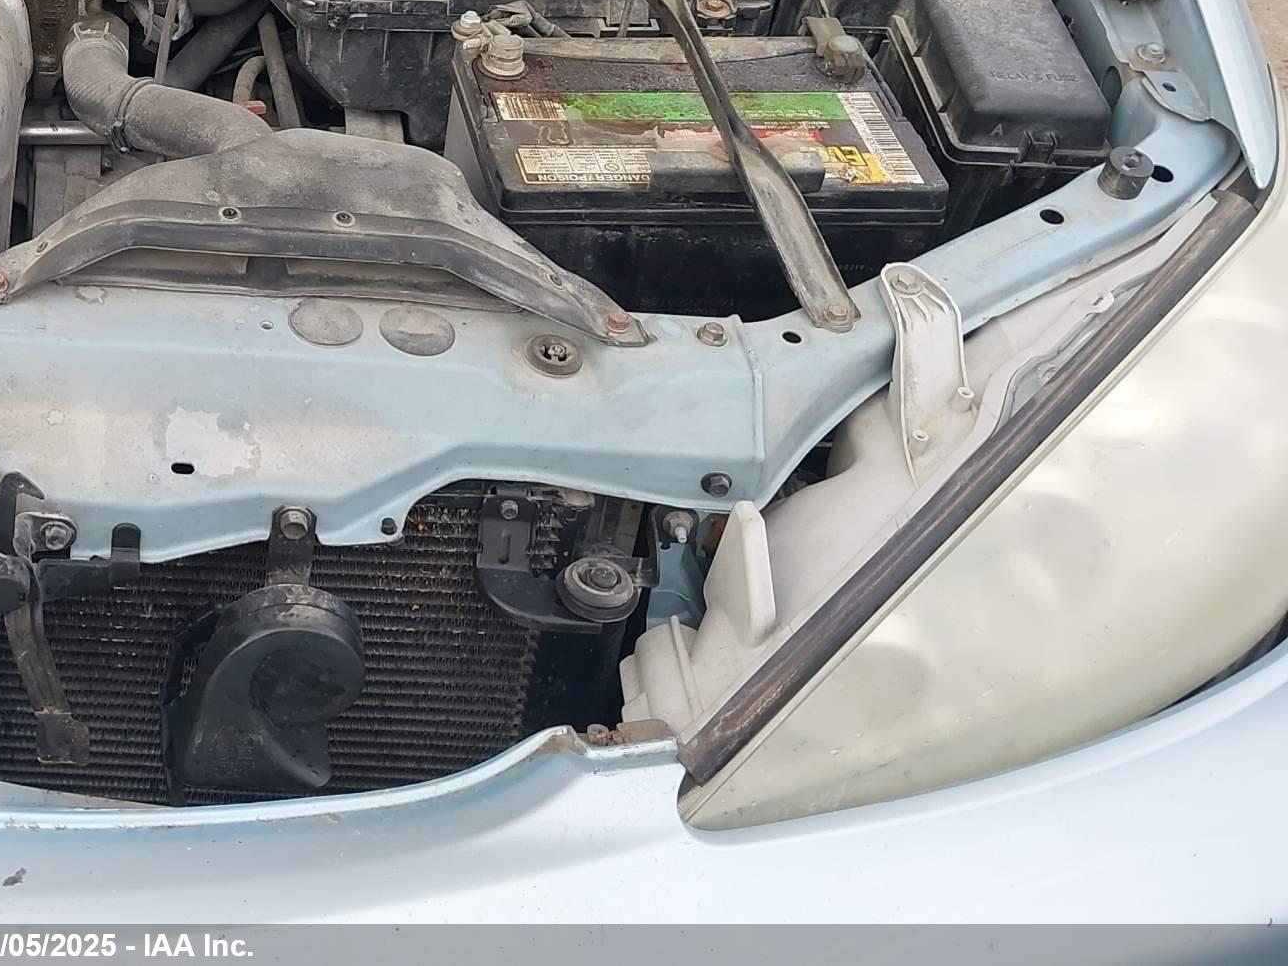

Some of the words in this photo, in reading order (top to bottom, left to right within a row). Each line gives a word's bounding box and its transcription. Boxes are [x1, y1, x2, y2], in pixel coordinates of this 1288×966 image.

[990, 71, 1029, 82] RELAY
[1045, 73, 1081, 83] FUSE
[989, 122, 1004, 137] A
